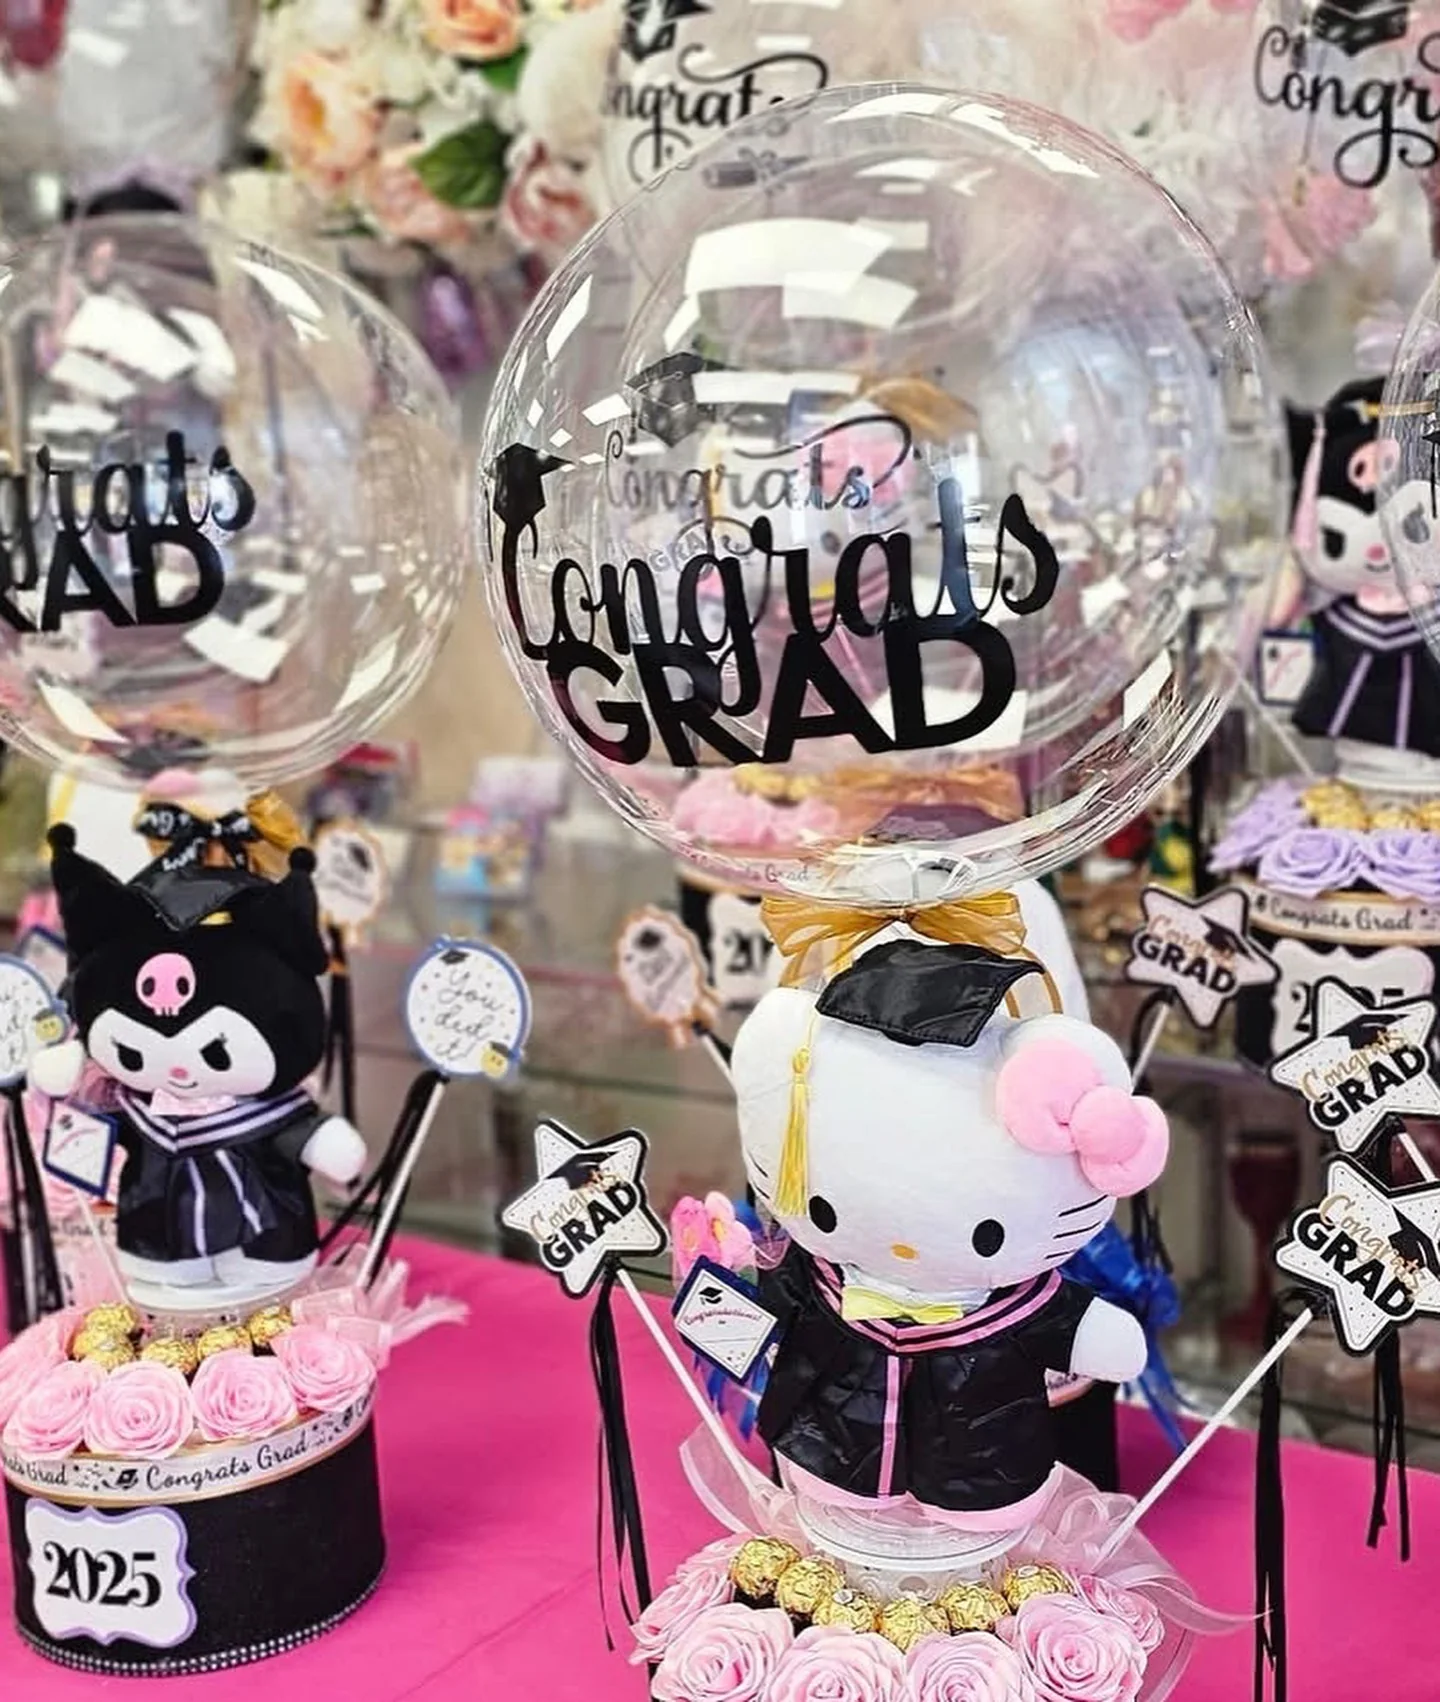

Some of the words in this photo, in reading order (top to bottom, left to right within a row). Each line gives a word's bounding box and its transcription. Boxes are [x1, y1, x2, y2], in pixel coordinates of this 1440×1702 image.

[1255, 25, 1440, 188] Congr
[0, 525, 225, 632] AD
[501, 477, 1060, 717] Congrats
[547, 612, 1017, 767] GRAD
[1270, 897, 1350, 928] Congrats
[1355, 907, 1413, 930] Grad
[438, 968, 506, 1011] You
[1137, 933, 1236, 994] GRAD
[434, 1004, 494, 1042] did
[1301, 1029, 1410, 1103] Congrats
[1313, 1045, 1425, 1126] GRAD
[543, 1182, 637, 1267] GRAD
[1297, 1211, 1415, 1316] GRAD
[1319, 1194, 1421, 1297] Congrats
[26, 1457, 68, 1485] Grad
[146, 1455, 252, 1491] Congrats
[257, 1432, 310, 1469] Grad
[43, 1541, 162, 1608] 2025
